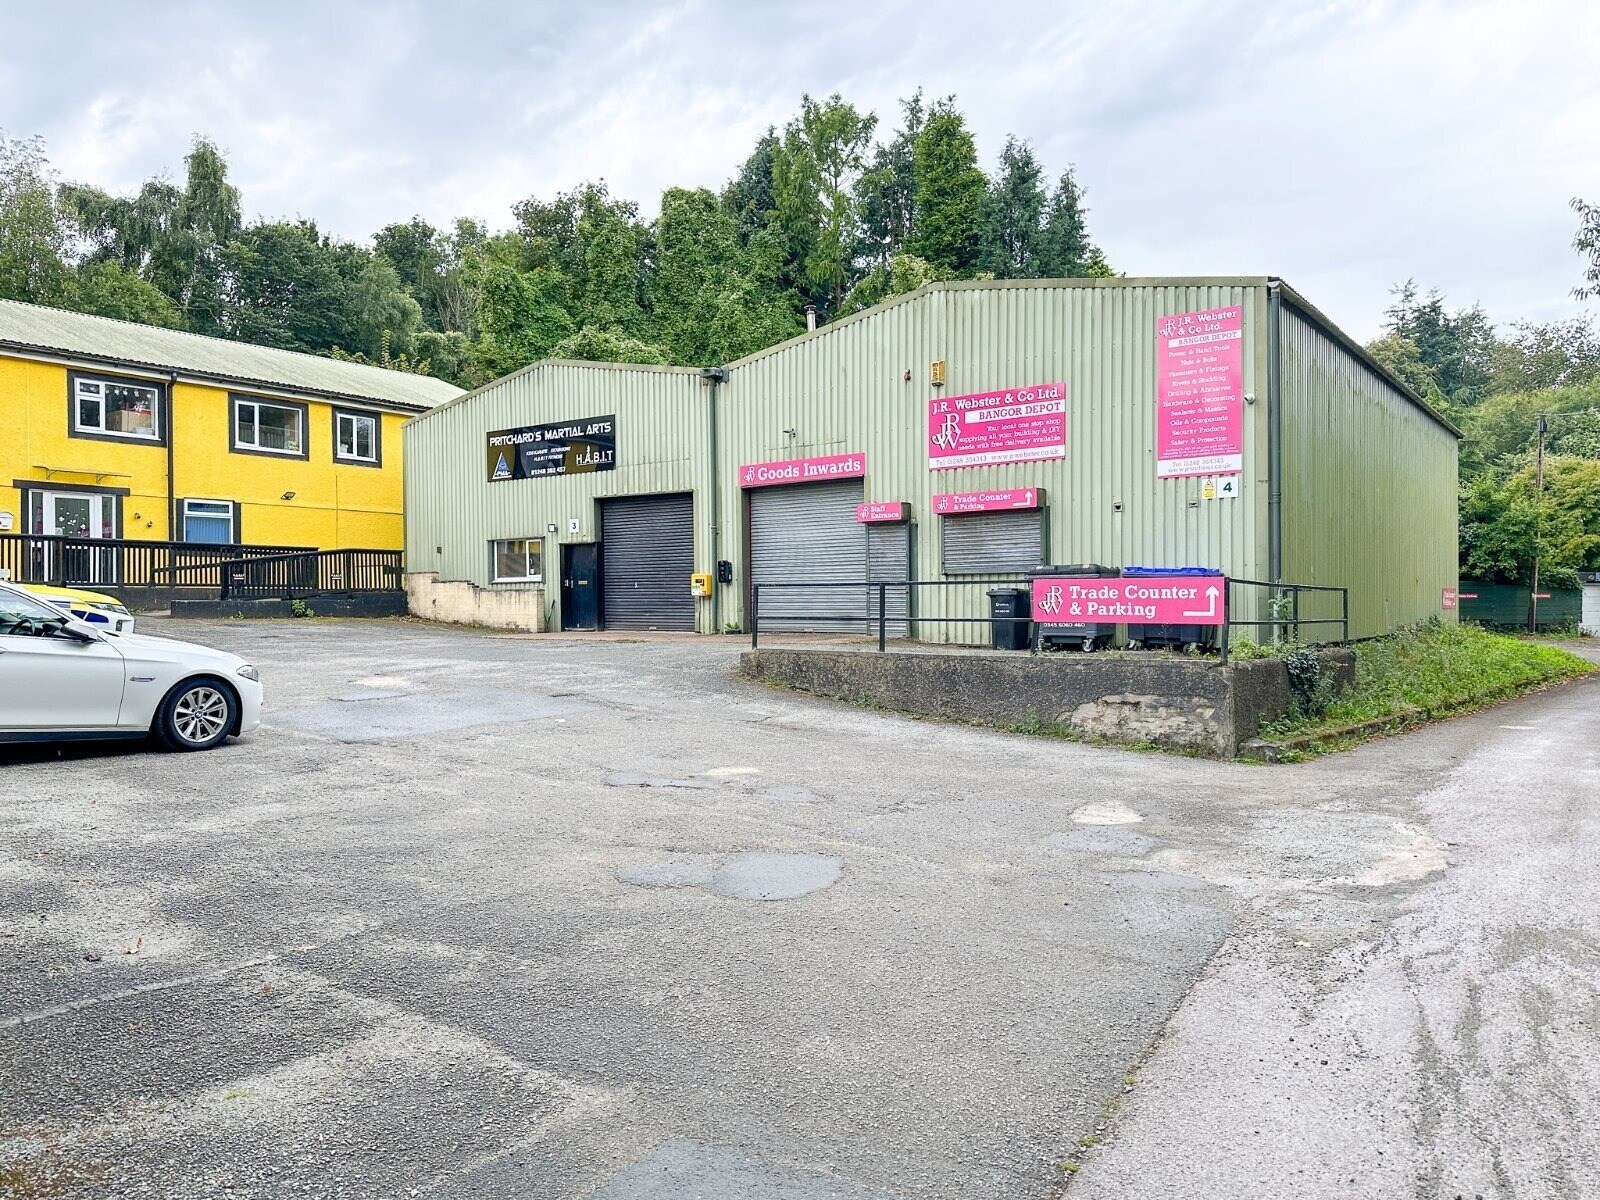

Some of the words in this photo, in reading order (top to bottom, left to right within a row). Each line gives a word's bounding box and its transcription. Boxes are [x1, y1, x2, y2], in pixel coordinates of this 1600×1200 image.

[1178, 316, 1194, 327] J.R.
[1197, 311, 1237, 322] Webster
[1177, 327, 1186, 336] &
[1188, 325, 1202, 334] Co
[1204, 322, 1223, 332] Ltd.
[1178, 335, 1210, 345] BANGOR
[1211, 331, 1238, 341] DEPOT
[1195, 346, 1212, 354] Hand
[932, 401, 951, 415] J.R.
[955, 396, 1001, 411] Webster
[1004, 393, 1014, 404] &
[1017, 391, 1035, 402] Co
[1037, 387, 1062, 400] Ltd.
[979, 407, 1023, 420] BANGOR
[1025, 402, 1062, 414] DEPOT
[1001, 422, 1016, 430] local
[1046, 418, 1061, 426] shop
[1191, 415, 1229, 424] Compounds
[489, 431, 542, 447] PRITCHARD'S
[544, 426, 585, 441] MARTIAL
[586, 422, 612, 435] ARTS
[959, 435, 987, 443] supplying
[999, 432, 1013, 440] your
[1014, 428, 1041, 437] building
[976, 441, 990, 449] with
[1005, 437, 1031, 446] delivery
[1033, 435, 1061, 443] available
[757, 465, 800, 481] Goods
[804, 458, 861, 477] Inwards
[1223, 482, 1233, 493] 4
[953, 494, 977, 504] Trade
[979, 493, 1012, 502] Counter
[870, 505, 886, 513] Staff
[960, 502, 985, 510] Parking
[870, 511, 900, 519] Entrance
[571, 522, 577, 530] 3
[1069, 585, 1120, 600] Trade
[1124, 584, 1198, 600] Counter
[1069, 601, 1083, 616] &
[1087, 601, 1157, 618] Parking
